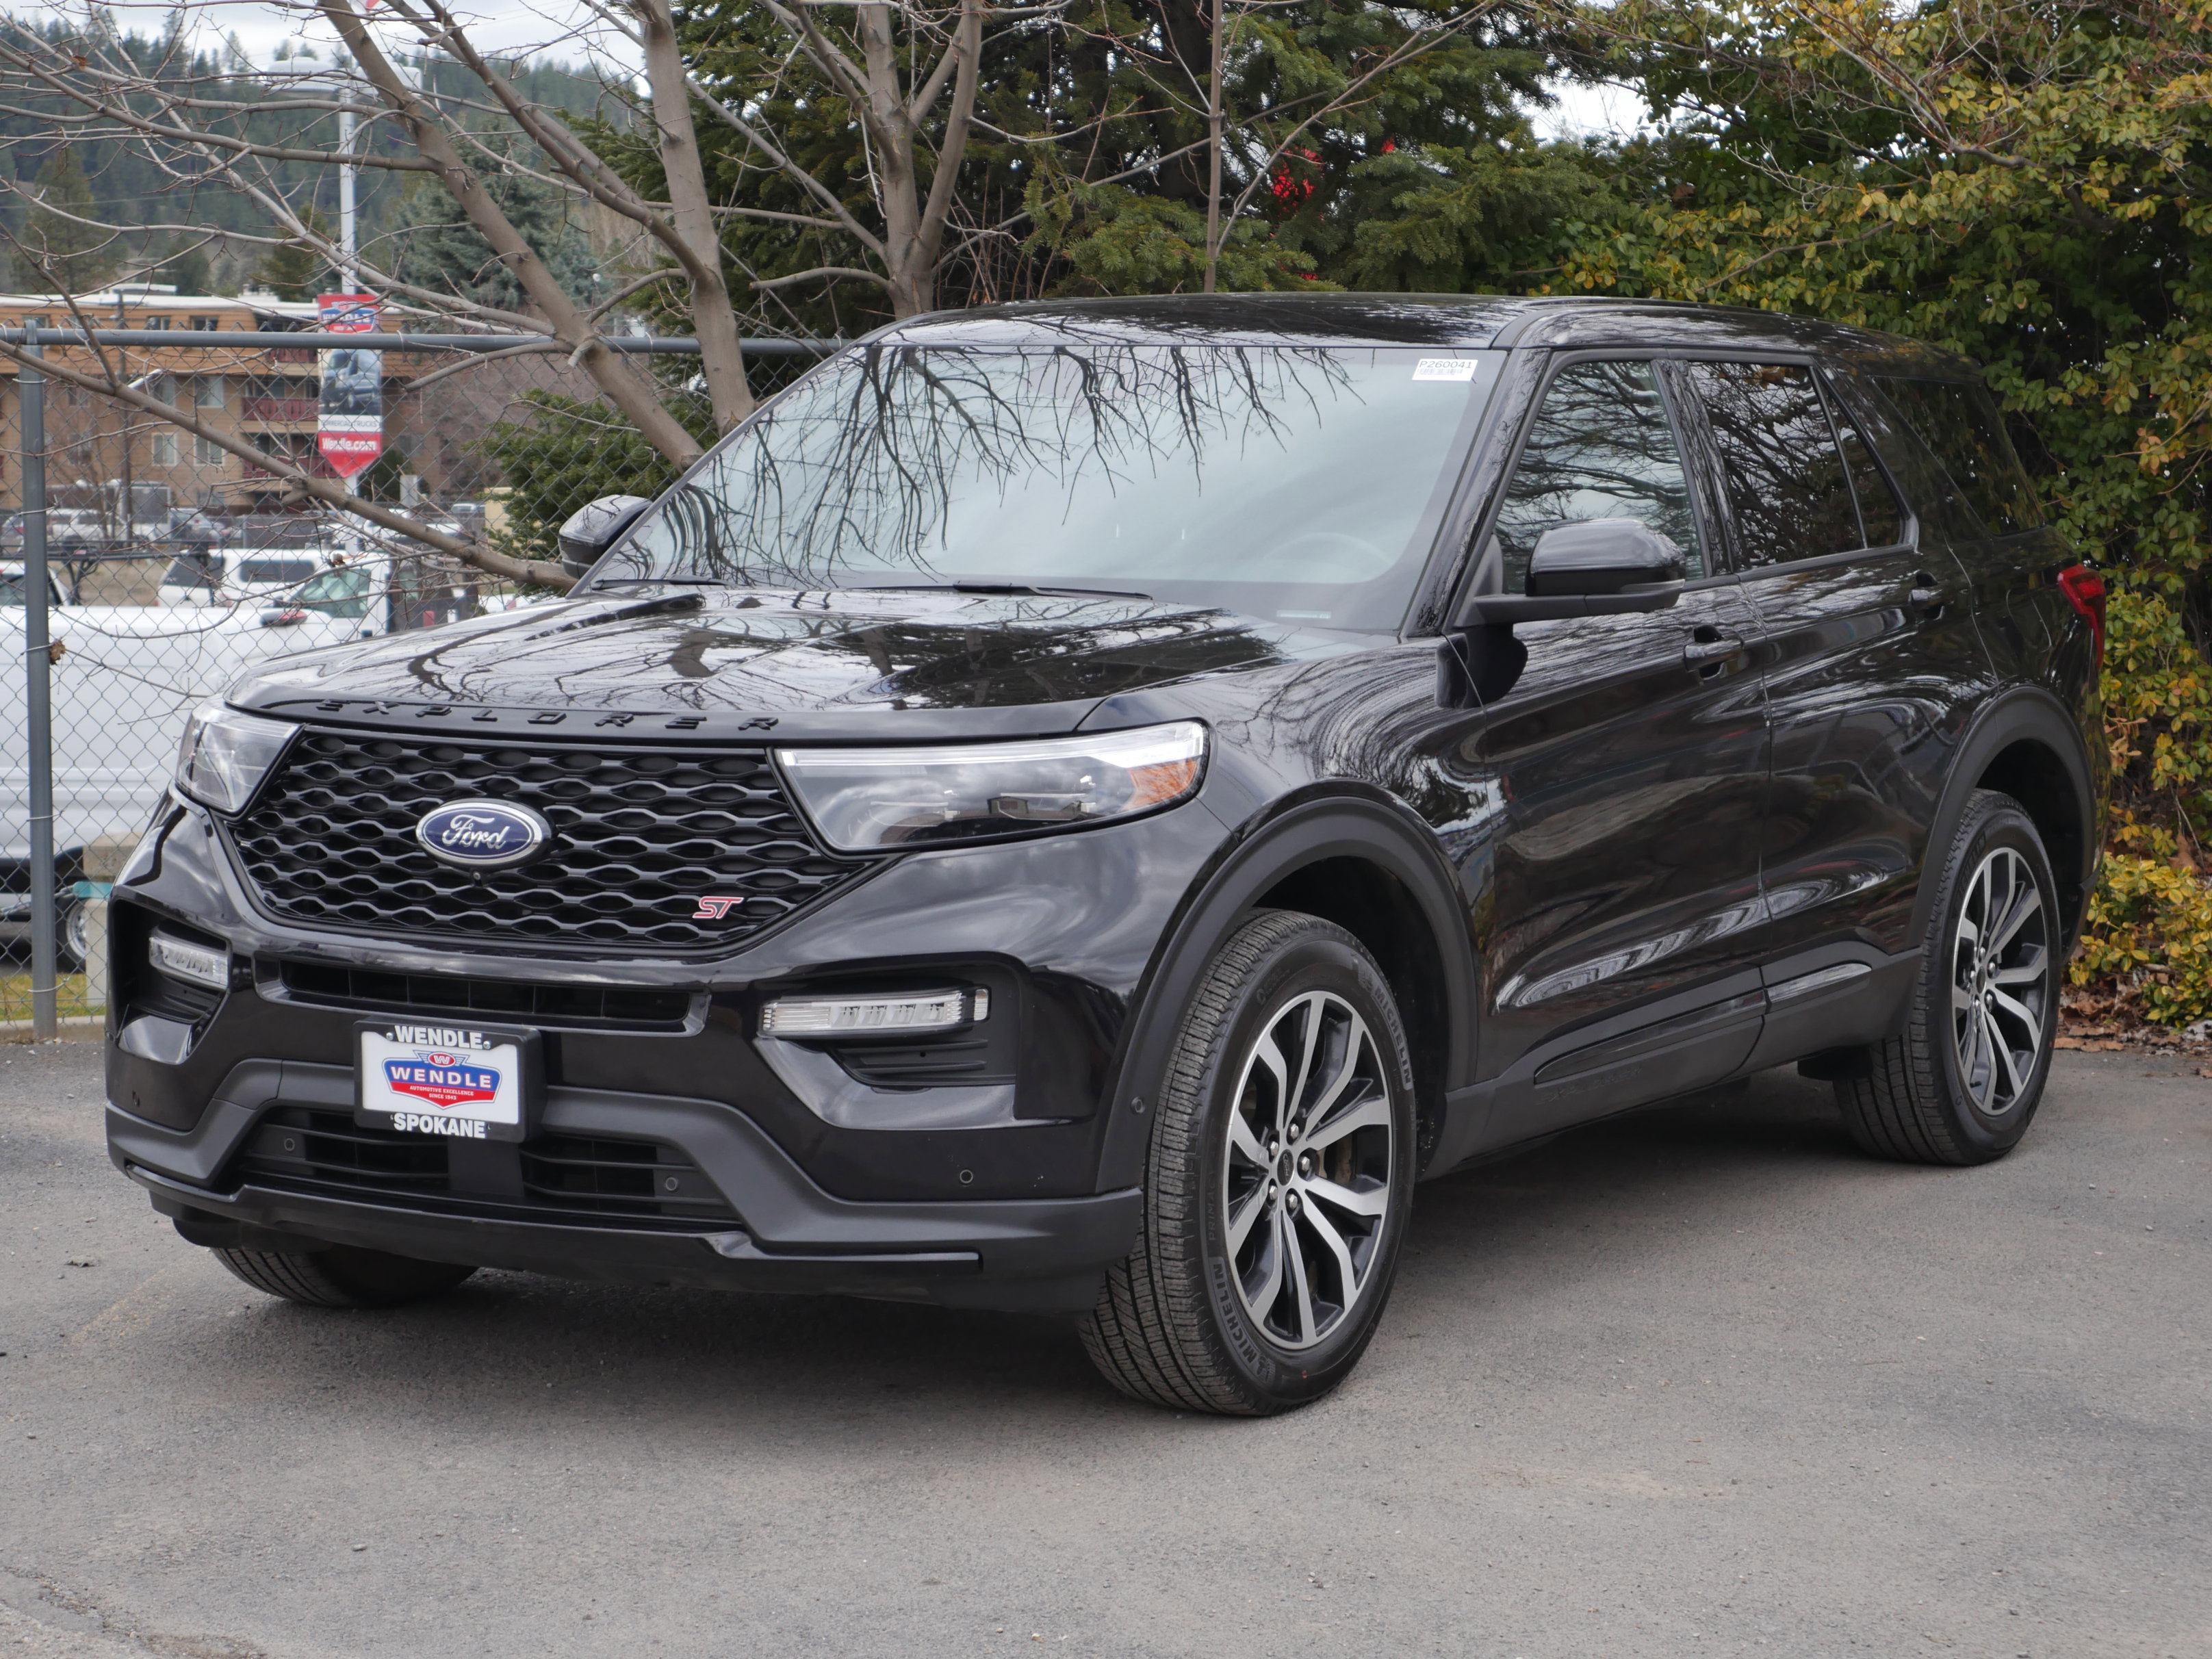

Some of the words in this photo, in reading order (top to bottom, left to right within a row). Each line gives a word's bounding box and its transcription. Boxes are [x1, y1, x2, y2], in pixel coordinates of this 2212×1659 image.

[322, 437, 377, 451] Wendle.com
[316, 699, 779, 731] EXPLORER
[442, 814, 510, 849] Ford
[692, 896, 744, 918] ST
[394, 1025, 483, 1049] WENDLE
[1374, 986, 1411, 1083] MICHELIN
[391, 1066, 491, 1088] WENDLE
[443, 1088, 474, 1096] EXCELLENCE
[394, 1113, 486, 1138] SPOKANE
[1213, 1263, 1257, 1363] MICHELIN
